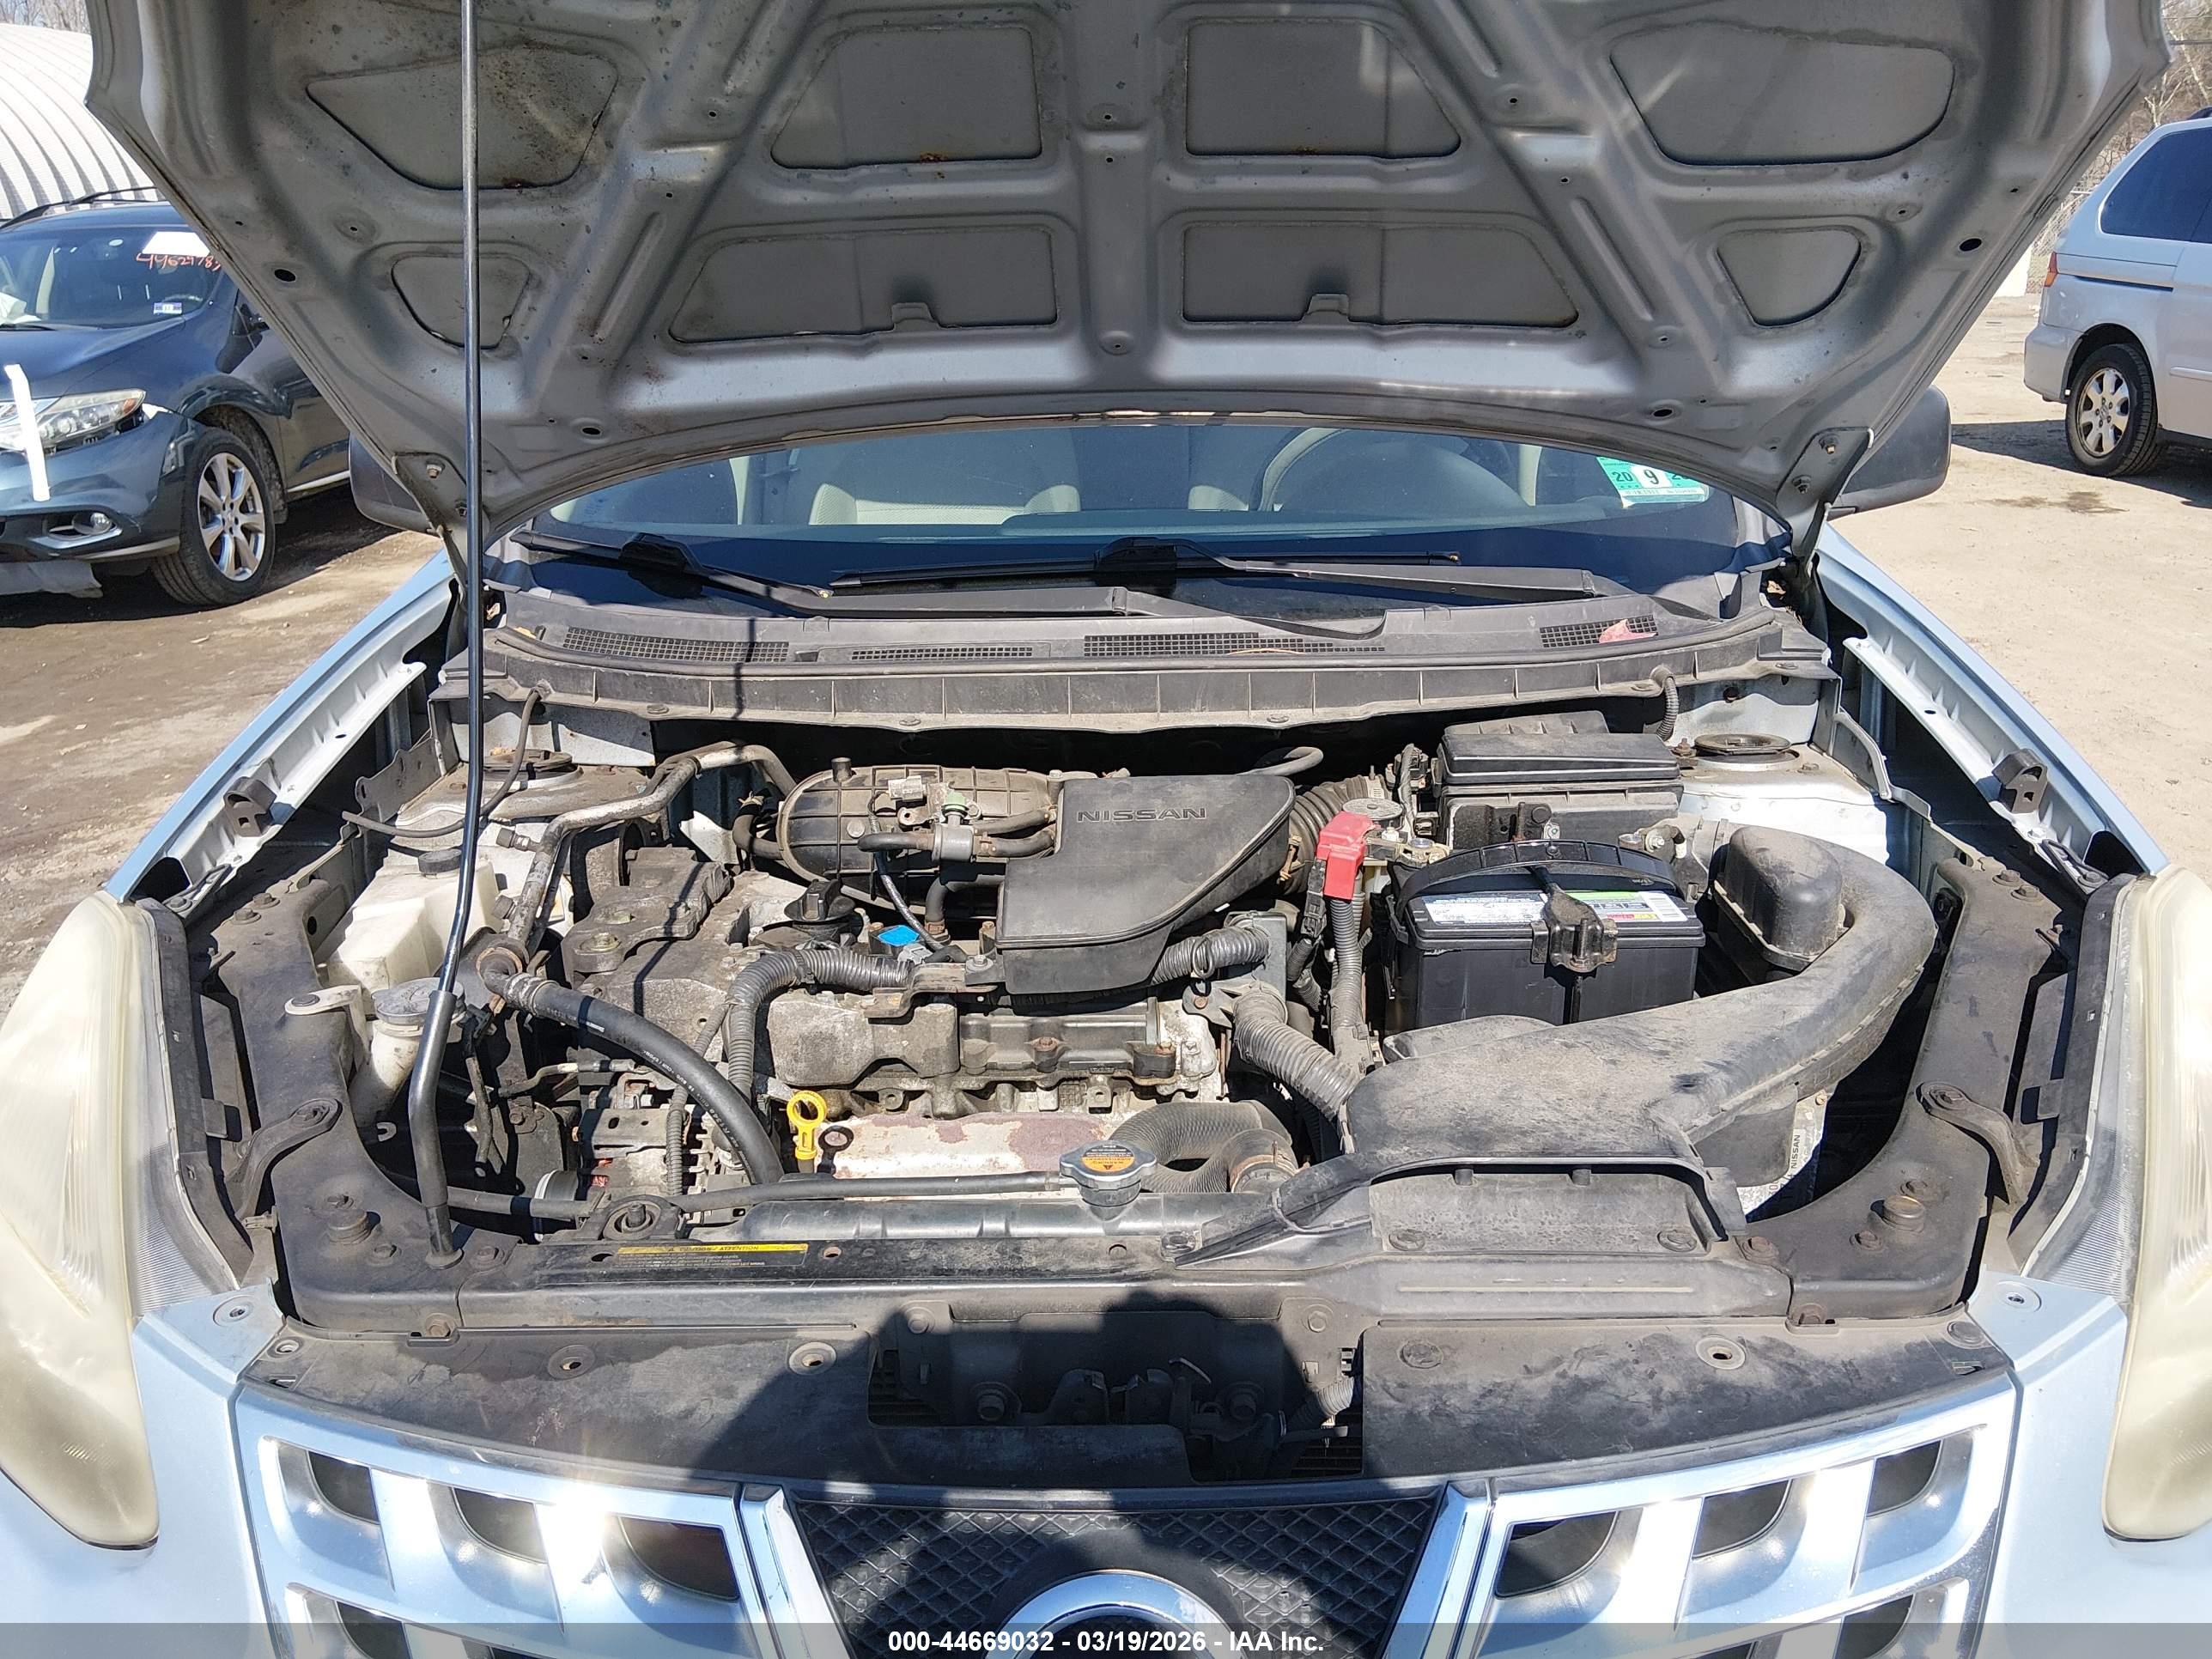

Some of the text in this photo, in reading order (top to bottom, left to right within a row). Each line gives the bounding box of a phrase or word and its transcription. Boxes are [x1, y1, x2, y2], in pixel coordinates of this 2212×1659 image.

[1611, 471, 1634, 483] 20
[1644, 469, 1660, 485] 9
[1078, 808, 1206, 822] NISSAN
[1790, 1133, 1801, 1169] NISSAN
